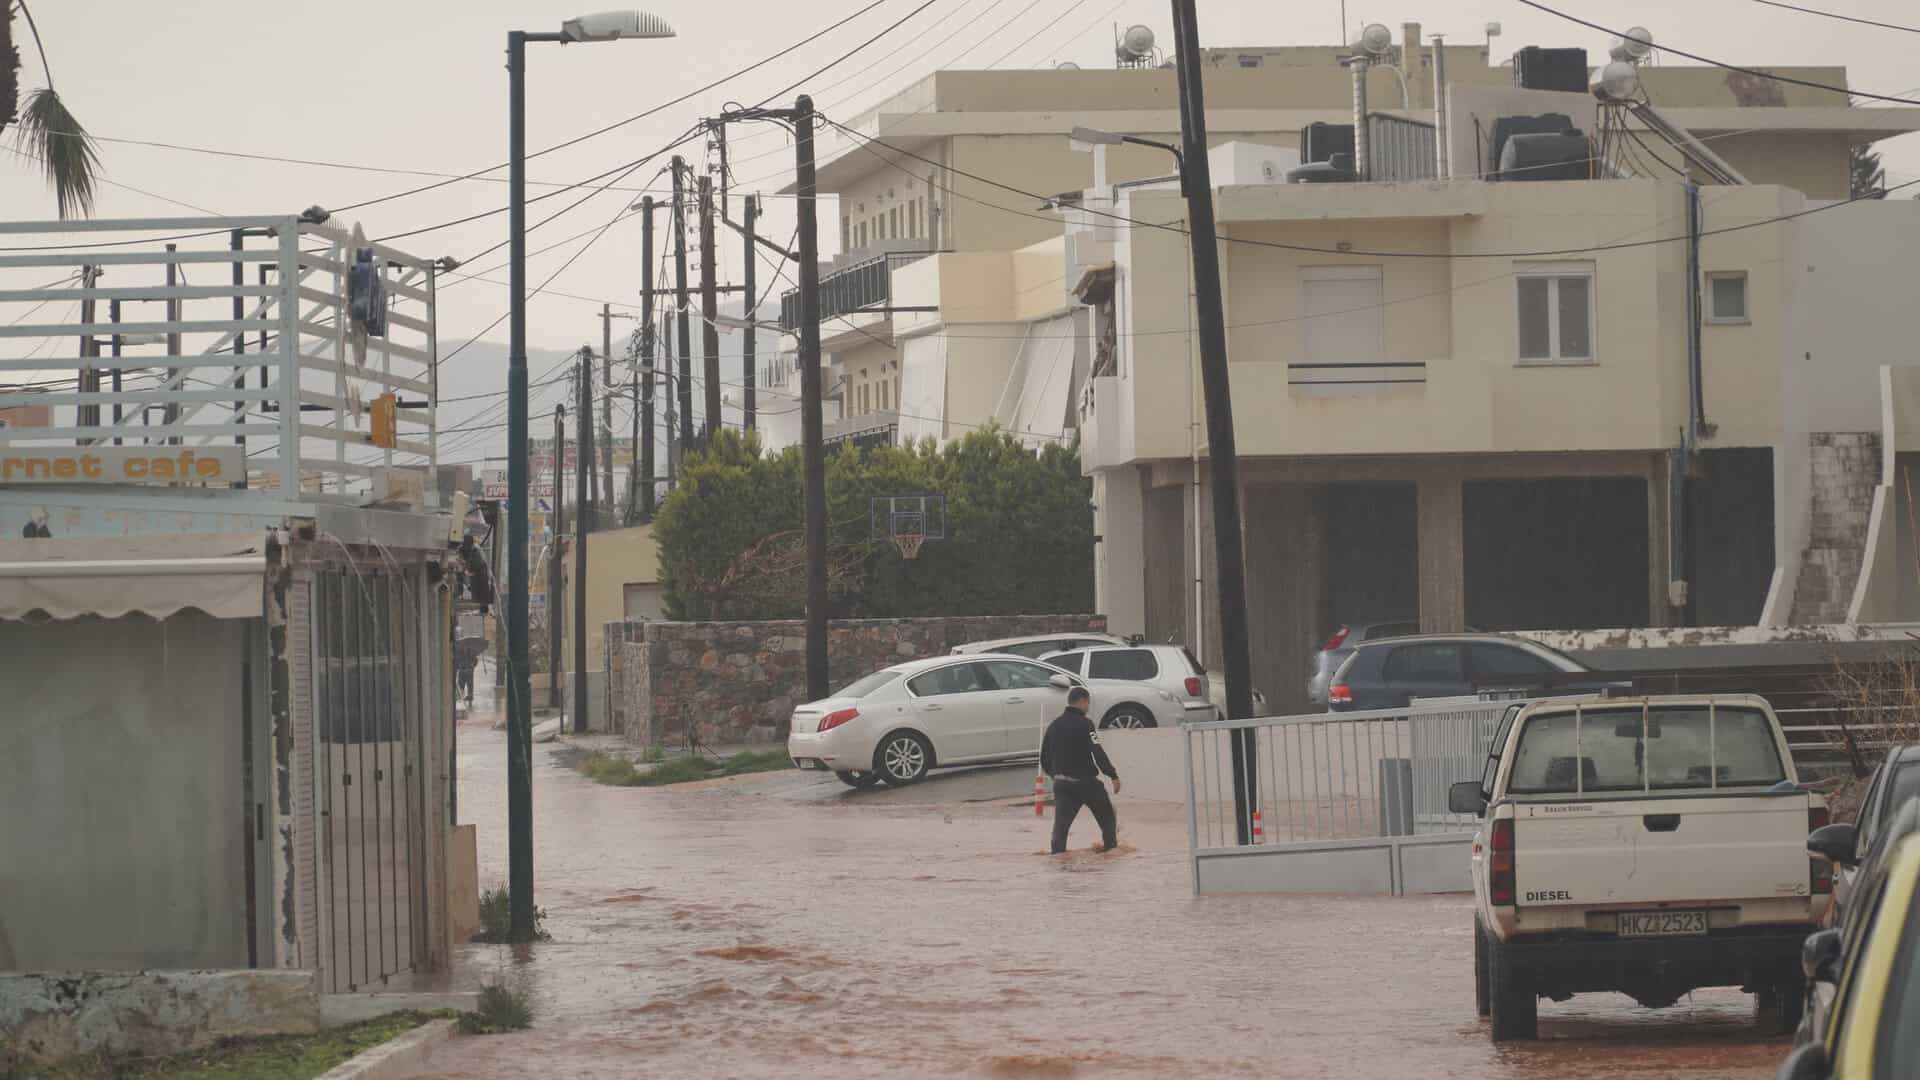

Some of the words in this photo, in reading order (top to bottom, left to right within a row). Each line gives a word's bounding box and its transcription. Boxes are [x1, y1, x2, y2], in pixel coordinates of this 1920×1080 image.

[2, 454, 103, 479] rnet
[124, 450, 222, 478] cafe
[1526, 890, 1573, 901] DIESEL
[1661, 912, 1705, 933] 2523
